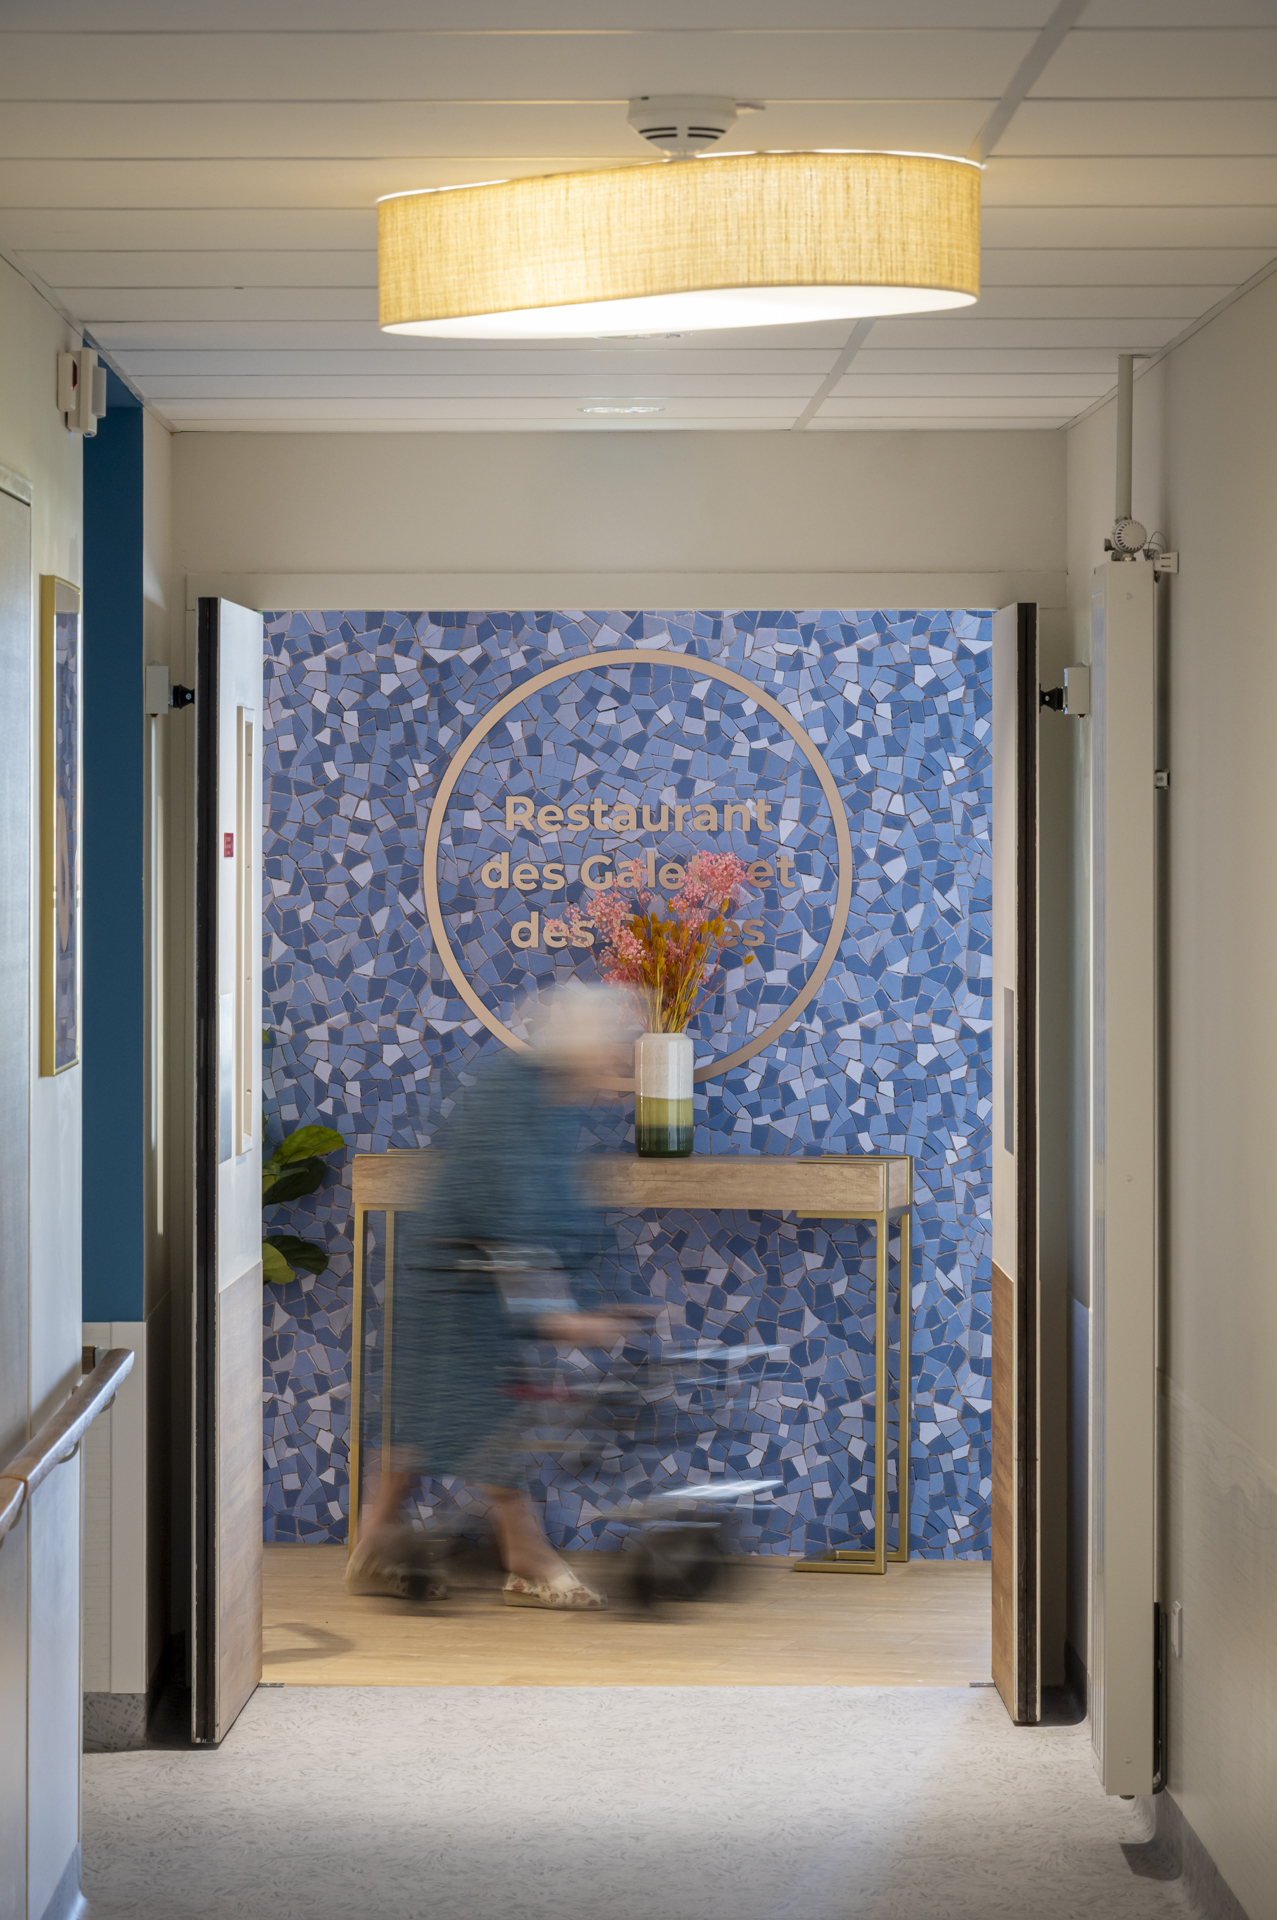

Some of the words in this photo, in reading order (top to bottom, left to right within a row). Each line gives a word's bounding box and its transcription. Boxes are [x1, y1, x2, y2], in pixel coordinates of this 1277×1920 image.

[505, 796, 772, 832] Restaurant
[480, 852, 565, 890] des
[747, 855, 796, 889] et
[510, 911, 596, 948] des
